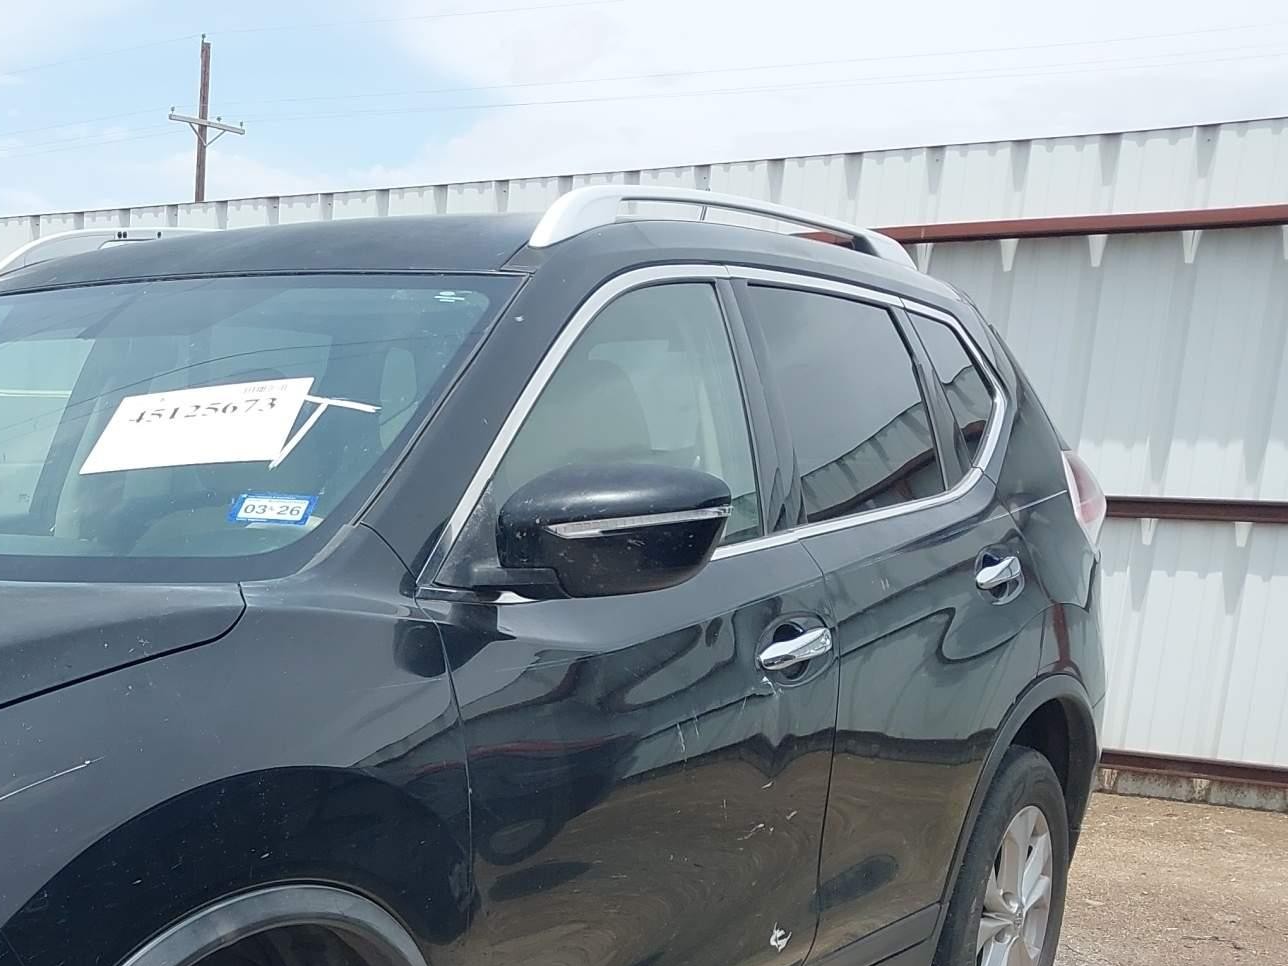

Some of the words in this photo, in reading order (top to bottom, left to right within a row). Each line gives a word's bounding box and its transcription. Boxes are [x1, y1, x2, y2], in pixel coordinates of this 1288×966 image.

[128, 396, 279, 424] 45125673
[243, 503, 267, 515] 03
[276, 504, 302, 517] 26
